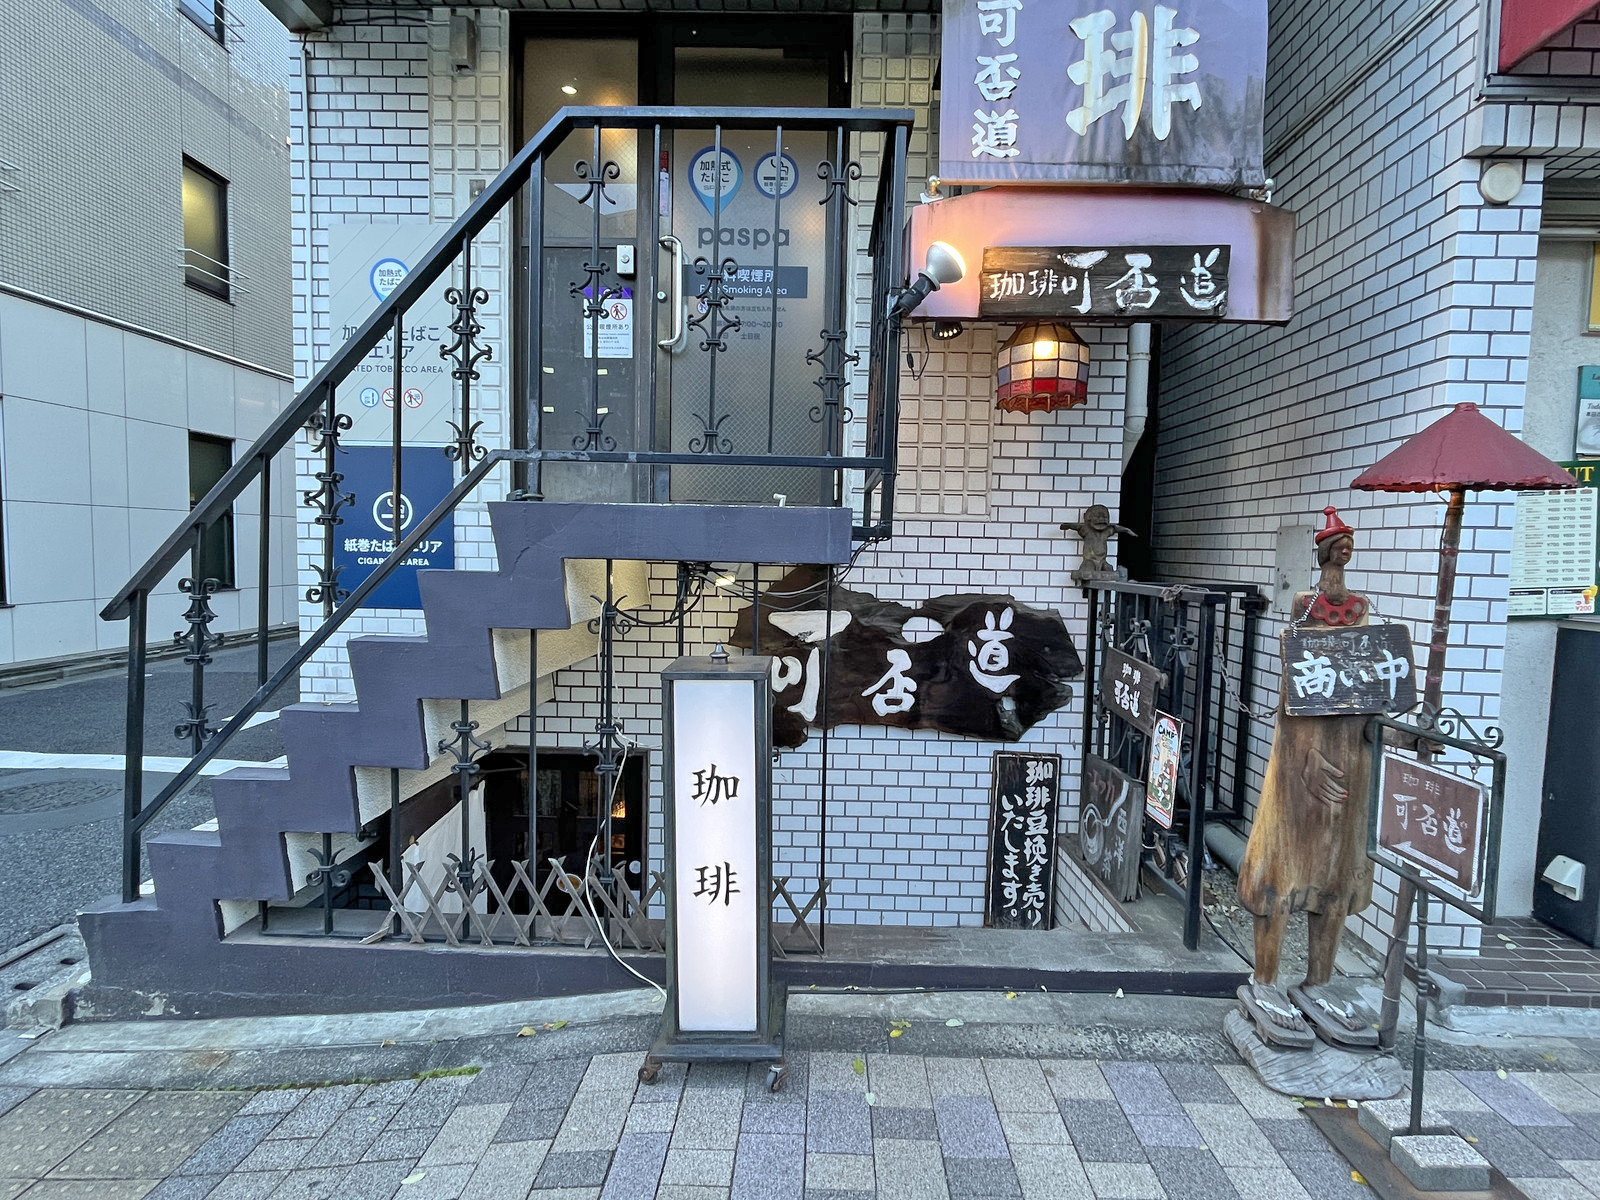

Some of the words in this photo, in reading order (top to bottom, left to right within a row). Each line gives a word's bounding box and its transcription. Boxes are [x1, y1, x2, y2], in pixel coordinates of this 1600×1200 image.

[1065, 4, 1202, 141] 琲
[698, 228, 790, 250] paspa
[378, 268, 402, 278] 加熱式
[710, 268, 774, 282] 料喫煙所
[988, 247, 1227, 314] 珈琲可否道
[699, 285, 720, 294] Fe
[722, 285, 762, 296] Smoking
[342, 324, 440, 342] 加ばこ
[375, 365, 418, 373] TOBCO
[344, 538, 442, 554] 紙巻たばリア
[1292, 649, 1410, 700] 商い中
[1402, 772, 1441, 797] 珈琲
[691, 763, 742, 907] 珈琲
[1392, 793, 1467, 856] 可否道
[1000, 794, 1024, 918] いたします。
[1021, 760, 1054, 927] 珈琲豆挽き売り
